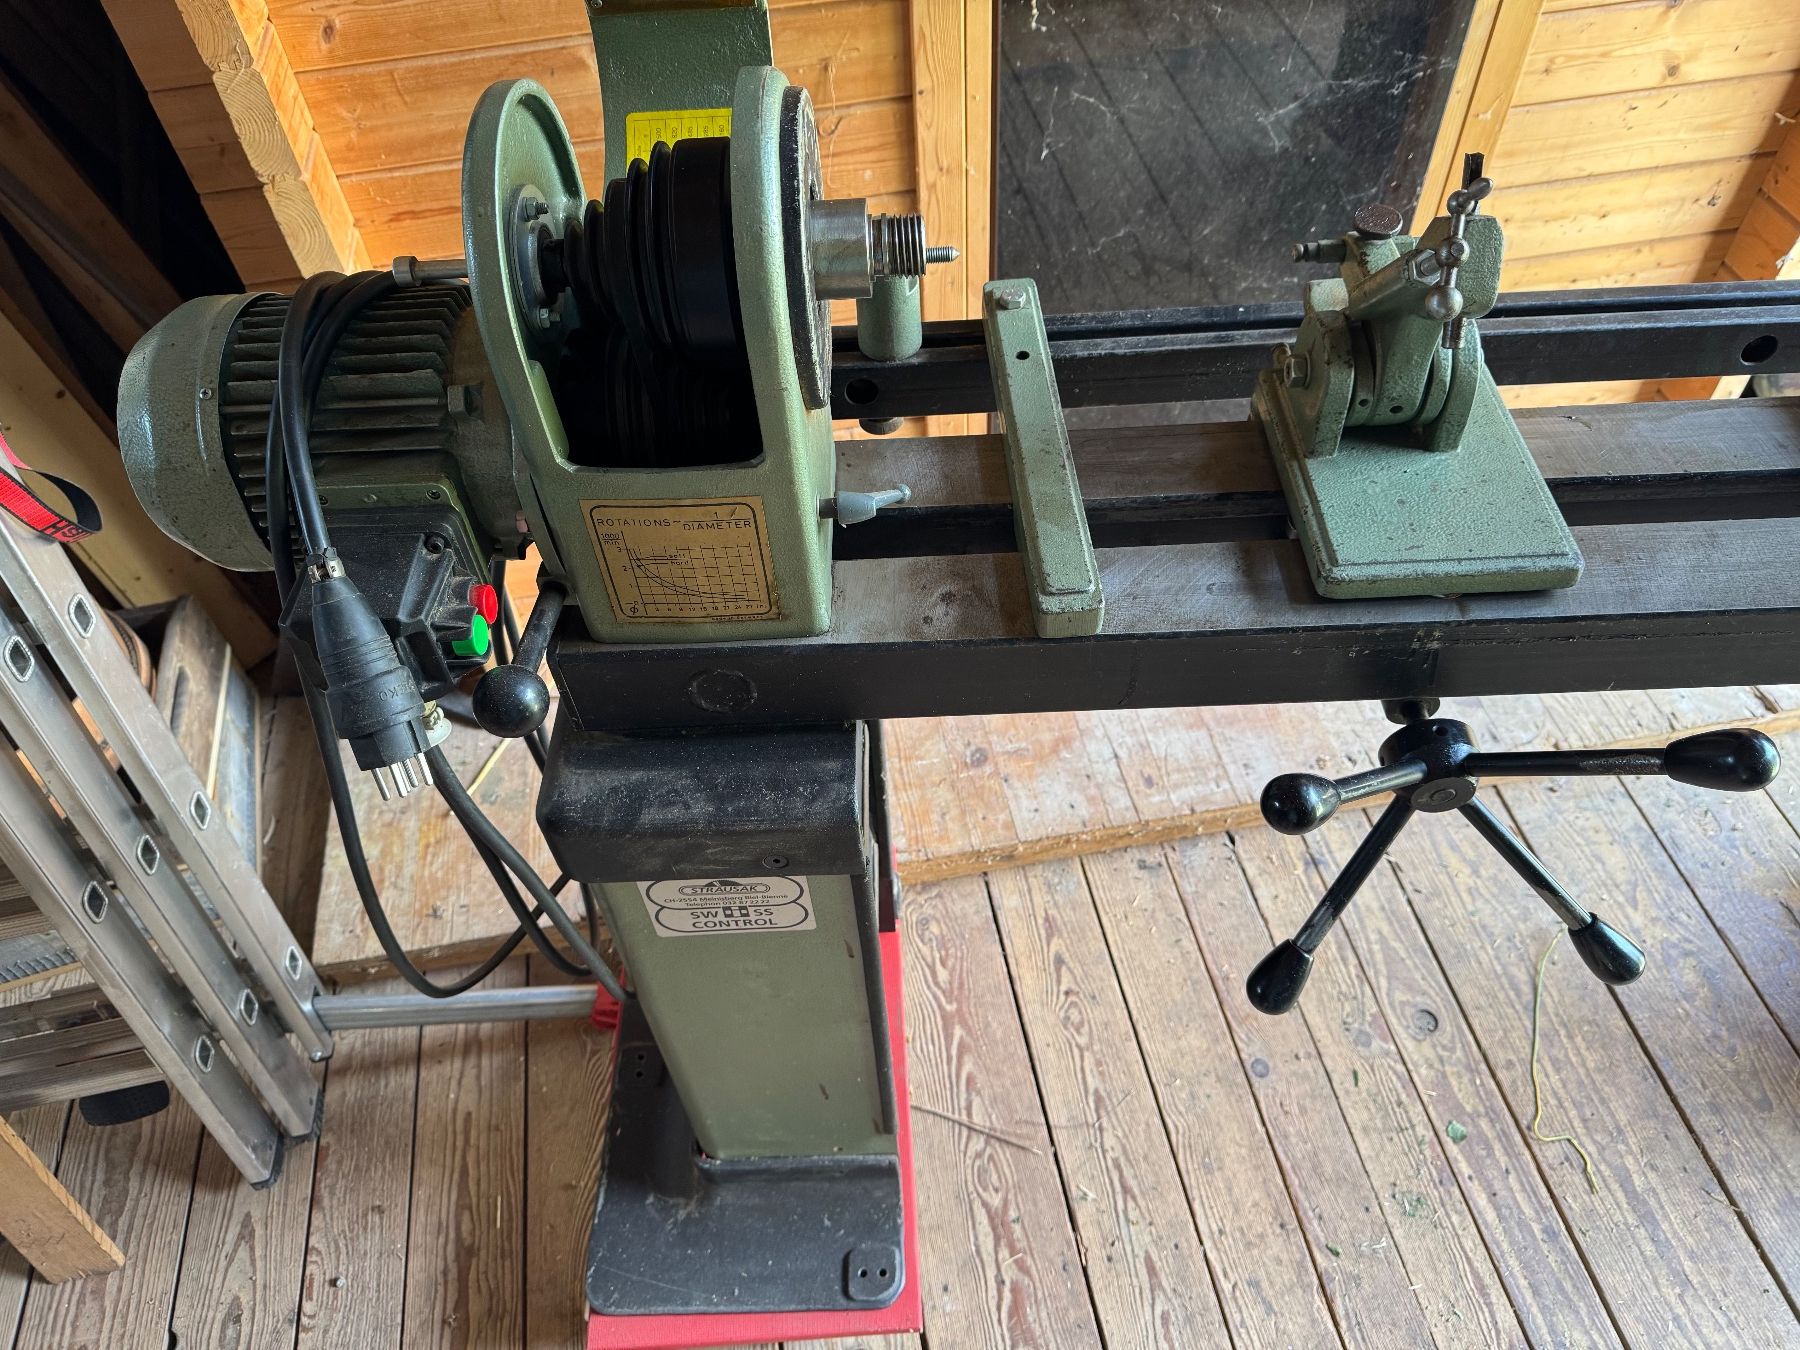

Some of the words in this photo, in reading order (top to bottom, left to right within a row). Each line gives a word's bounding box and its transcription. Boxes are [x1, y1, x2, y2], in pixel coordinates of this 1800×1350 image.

[596, 518, 671, 527] ROTATIONS
[683, 520, 752, 531] DIAMETER
[690, 885, 758, 894] STRAUSAK
[692, 918, 778, 929] CONTROL
